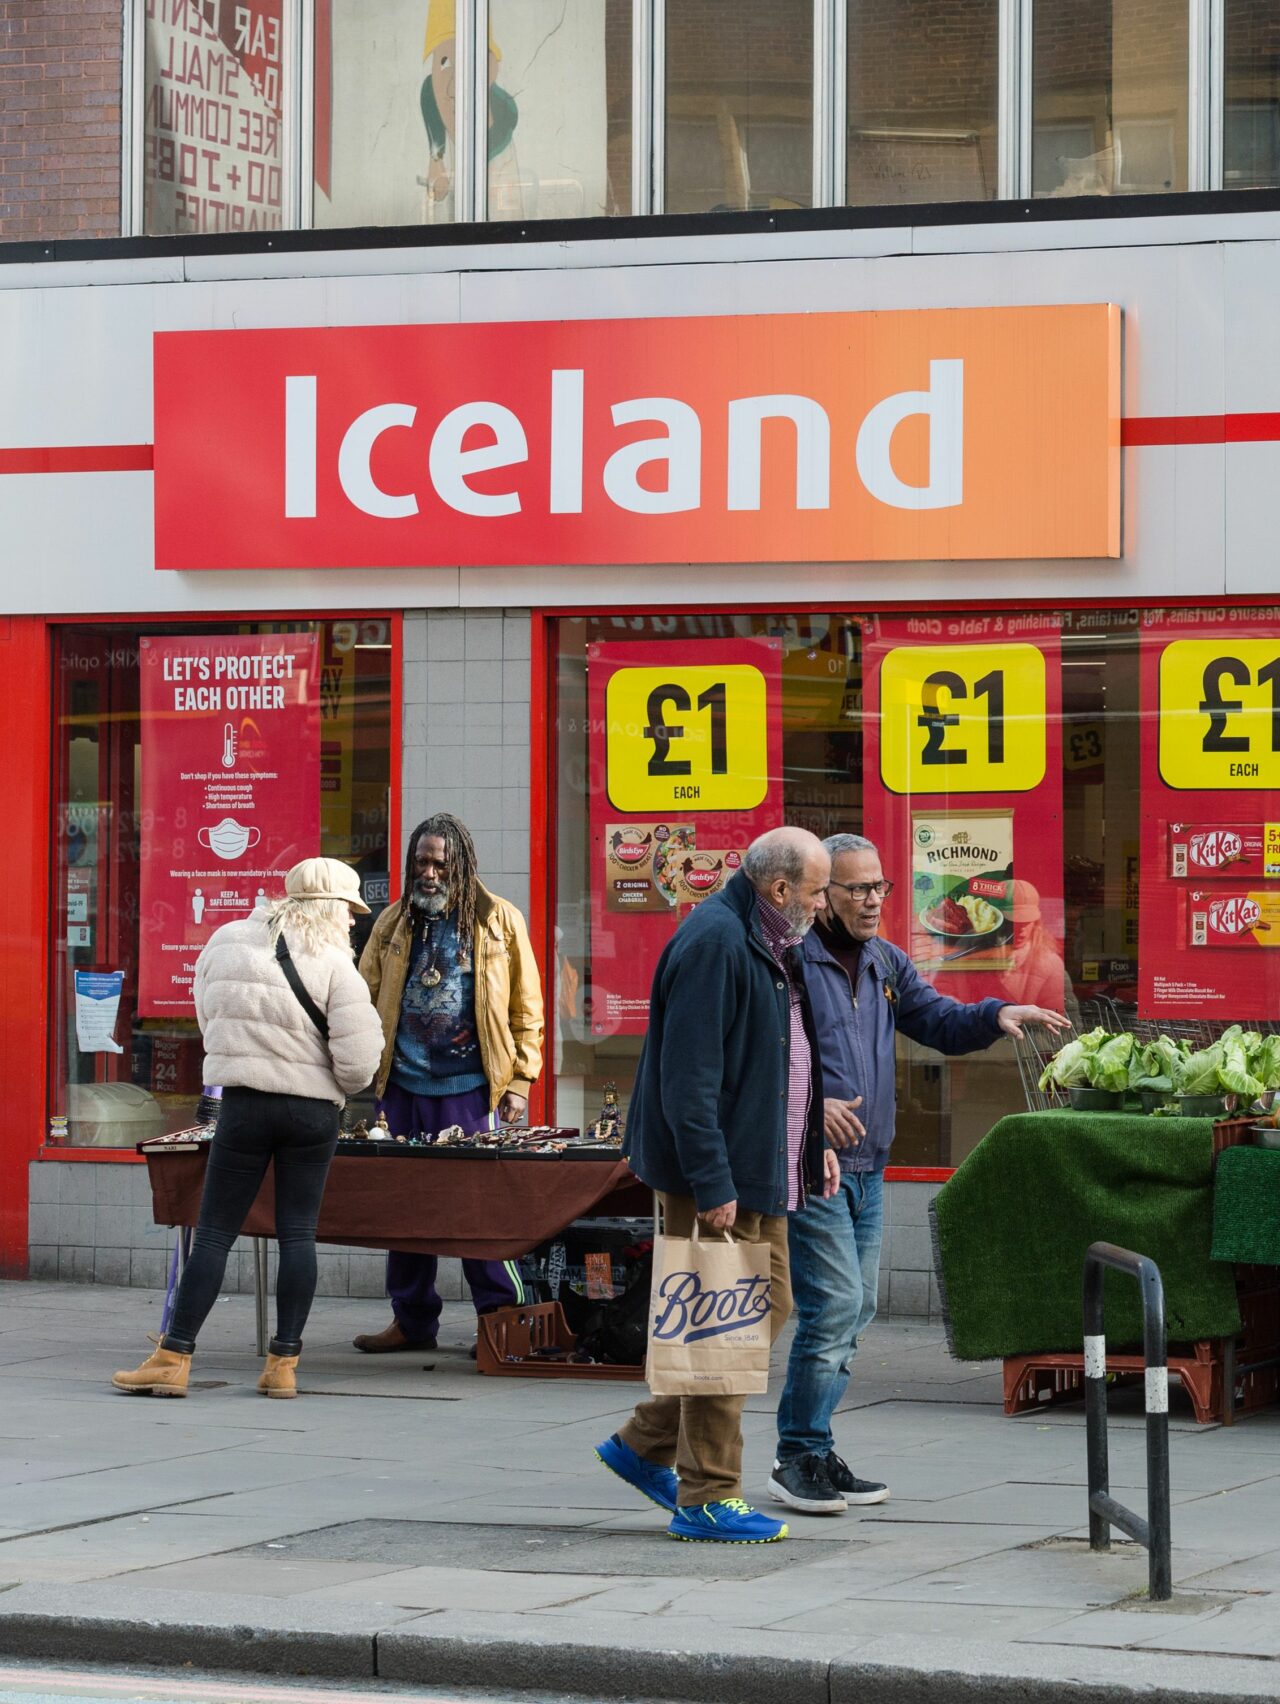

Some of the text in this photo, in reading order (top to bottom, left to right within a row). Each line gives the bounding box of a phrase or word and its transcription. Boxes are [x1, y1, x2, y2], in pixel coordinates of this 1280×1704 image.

[286, 359, 964, 518] Iceland
[163, 655, 295, 681] LET'S PROTECT
[174, 685, 285, 711] EACH OTHER
[918, 669, 1005, 765] £1
[644, 683, 728, 776] £1
[1230, 763, 1259, 777] EACH
[673, 786, 700, 799] EACH
[619, 847, 643, 855] BirdsEye
[927, 846, 999, 864] RICHMOND
[1194, 831, 1239, 867] KitKat
[170, 870, 191, 878] Wearing
[238, 870, 266, 878] mandatory
[689, 874, 714, 882] BirdsEye
[972, 882, 1003, 892] 8 THICK
[223, 898, 249, 906] DISTANCE
[1214, 898, 1258, 933] KitKat
[171, 975, 193, 984] Please
[155, 1063, 177, 1080] 24
[653, 1271, 772, 1344] Boots
